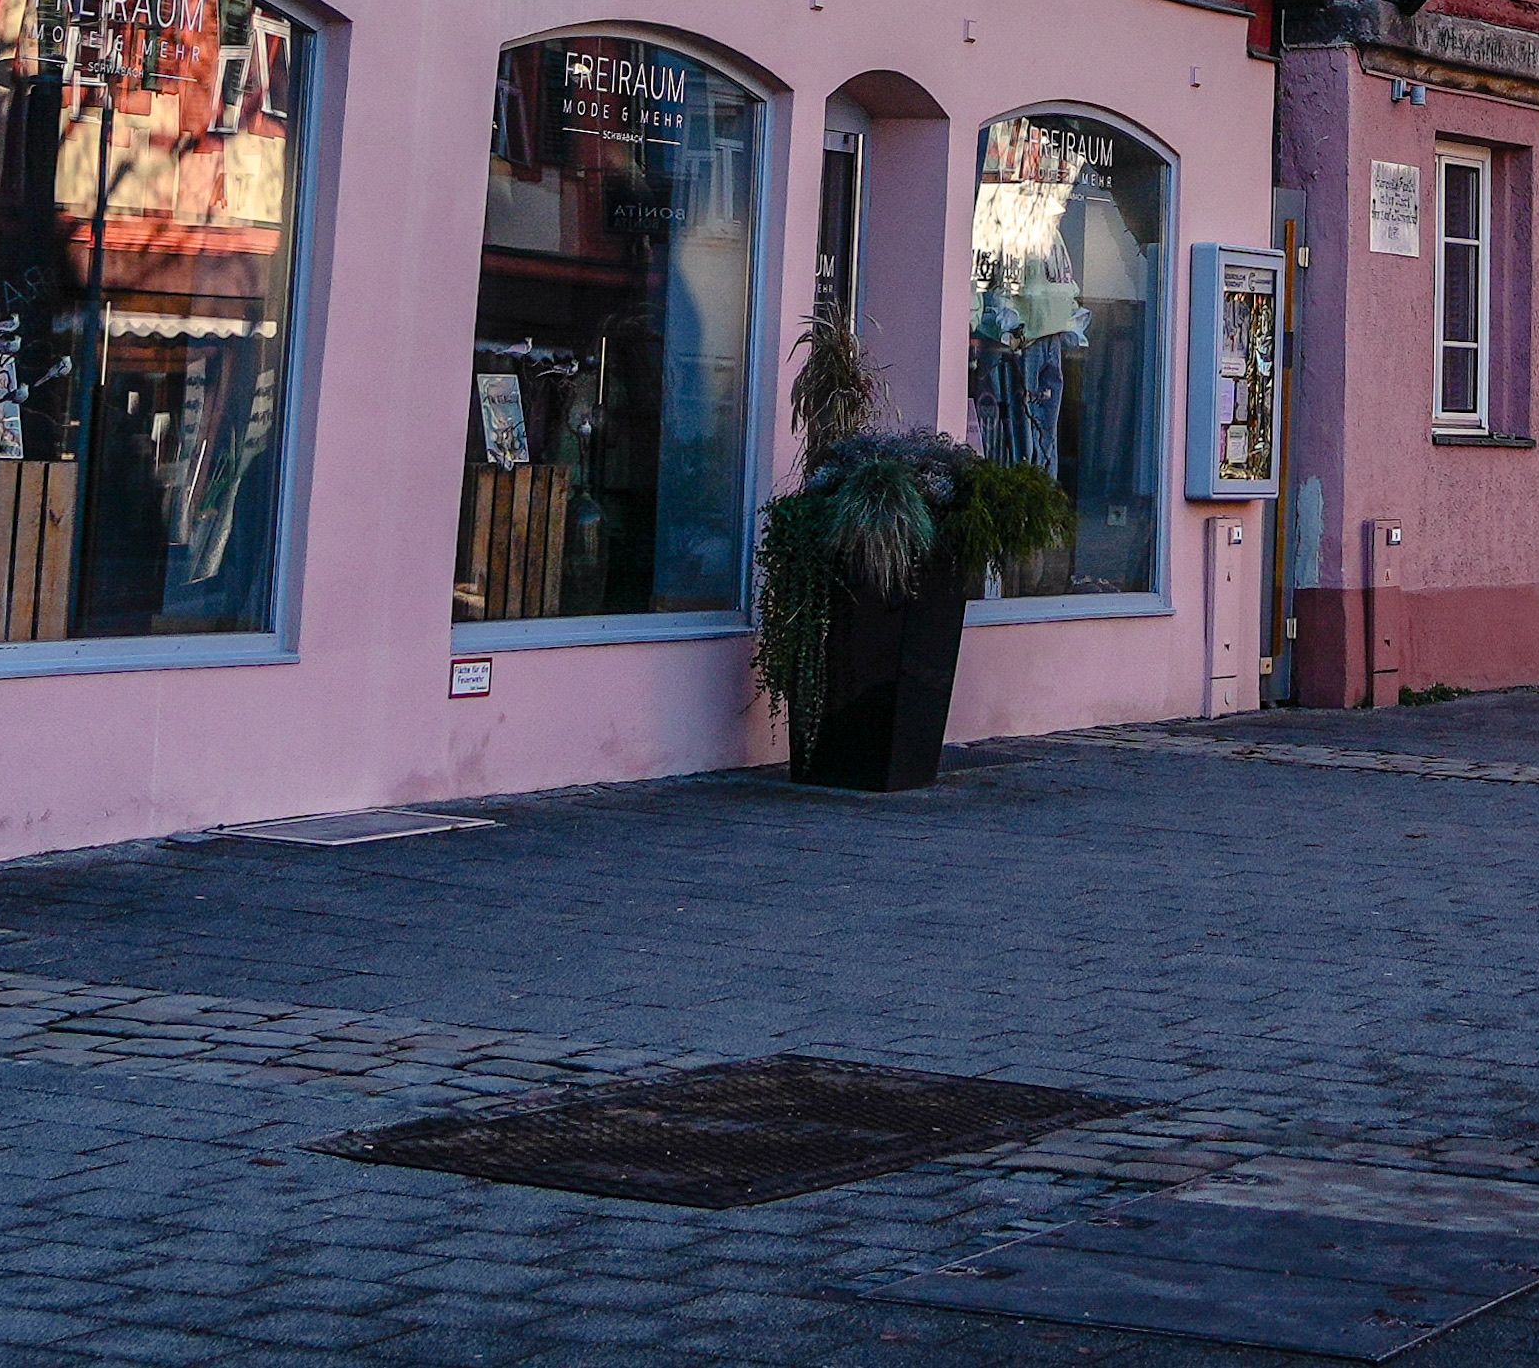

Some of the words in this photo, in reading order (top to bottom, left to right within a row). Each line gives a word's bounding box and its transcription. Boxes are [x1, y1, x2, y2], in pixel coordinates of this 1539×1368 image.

[34, 24, 98, 46] MODE
[141, 38, 201, 62] MEHR
[88, 62, 144, 78] SCHWABACH
[564, 52, 685, 104] FREIRAUM
[562, 99, 610, 119] MODE
[621, 107, 629, 122] &
[640, 109, 683, 129] MEHR
[602, 130, 643, 143] SCHWABACH
[1029, 126, 1114, 167] FREIRAUM
[1082, 172, 1113, 188] MEHR
